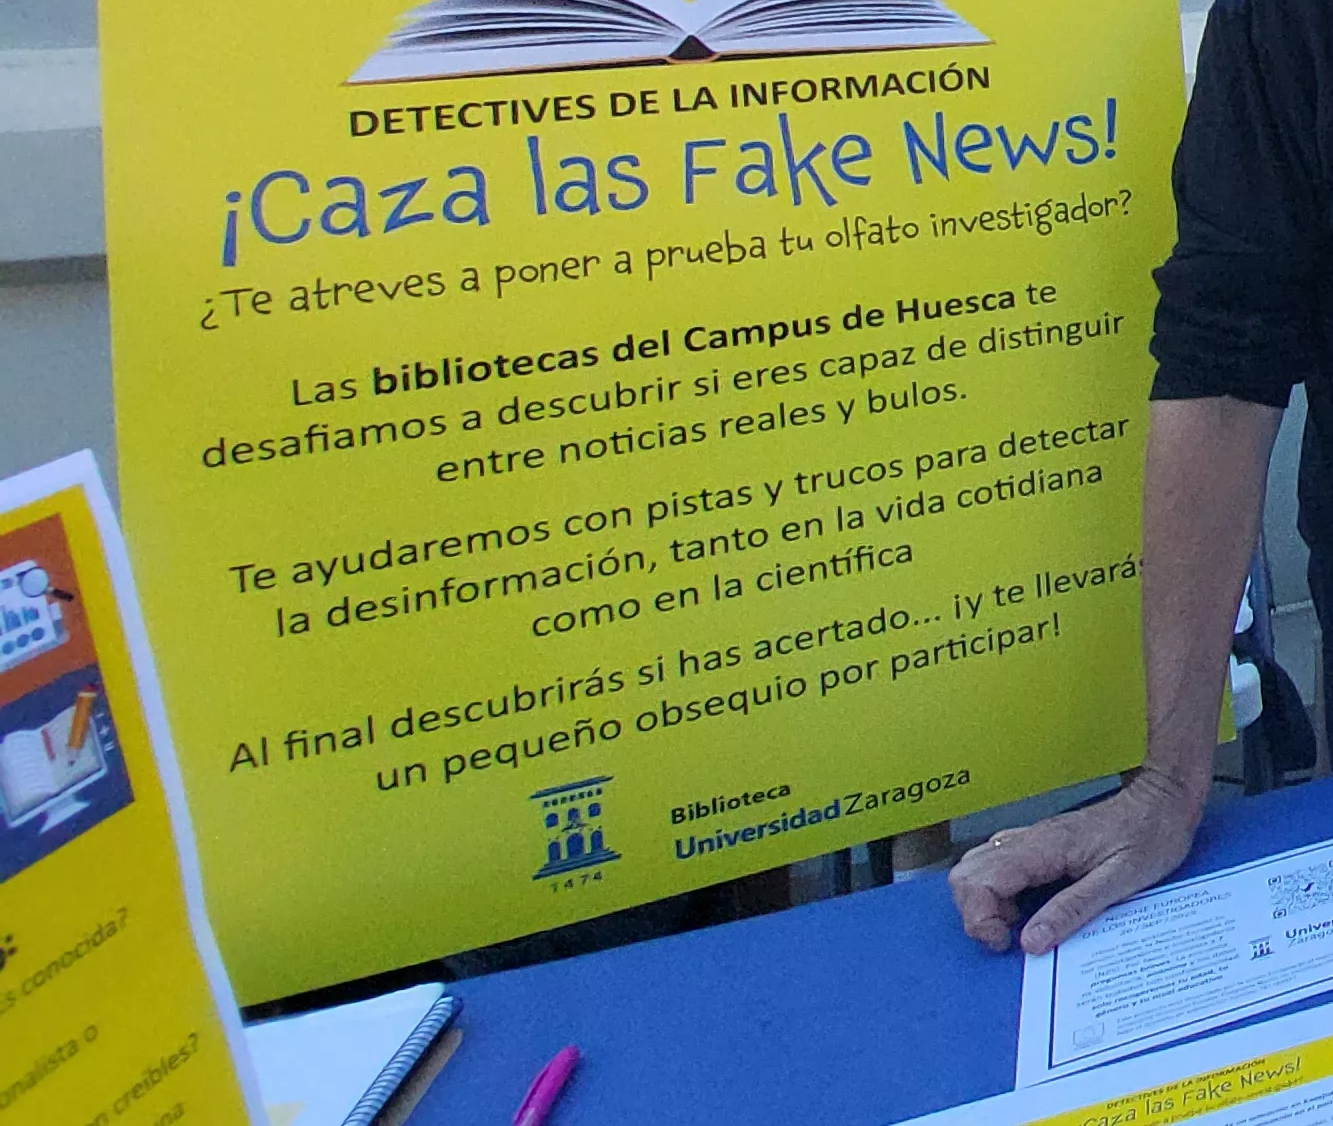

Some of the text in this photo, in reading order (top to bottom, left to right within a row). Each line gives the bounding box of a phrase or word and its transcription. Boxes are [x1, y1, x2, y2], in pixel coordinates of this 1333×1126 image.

[350, 62, 990, 137] DETECTIVES DE LA INFORMACIÓN
[220, 97, 1117, 267] ¡Caza las Fake News!
[201, 189, 1132, 331] ¿Te atreves a poner a prueba tu olfato investigador?
[203, 311, 1126, 469] desafiamos a descubrir si eres capaz de distinguir
[291, 282, 1058, 406] Las bibliotecas del Campus de Huesca te
[437, 381, 968, 483] entre noticias reales y bulos.
[230, 415, 1130, 594] Te ayudaremos con pistas y trucos para detectar
[276, 462, 1103, 638] la desinformación, tanto en la vida cotidiana
[532, 541, 914, 639] como en la científica
[230, 736, 269, 773] Al
[284, 715, 374, 762] final
[391, 667, 625, 739] descubrirás
[638, 655, 666, 686] si
[679, 643, 742, 678] has
[753, 607, 941, 660] acertado...
[953, 592, 984, 621] ¡y
[993, 582, 1025, 608] te
[376, 612, 1062, 792] un pequeño obsequio por participar!
[671, 781, 791, 825] Biblioteca
[674, 769, 971, 861] Universidad Zaragoza
[21, 906, 128, 996] conocida?
[0, 1039, 80, 1111] onalista
[1079, 1107, 1137, 1126] Caza
[1145, 1096, 1175, 1116] las
[1182, 1081, 1233, 1107] Fake
[1240, 1056, 1301, 1089] News!
